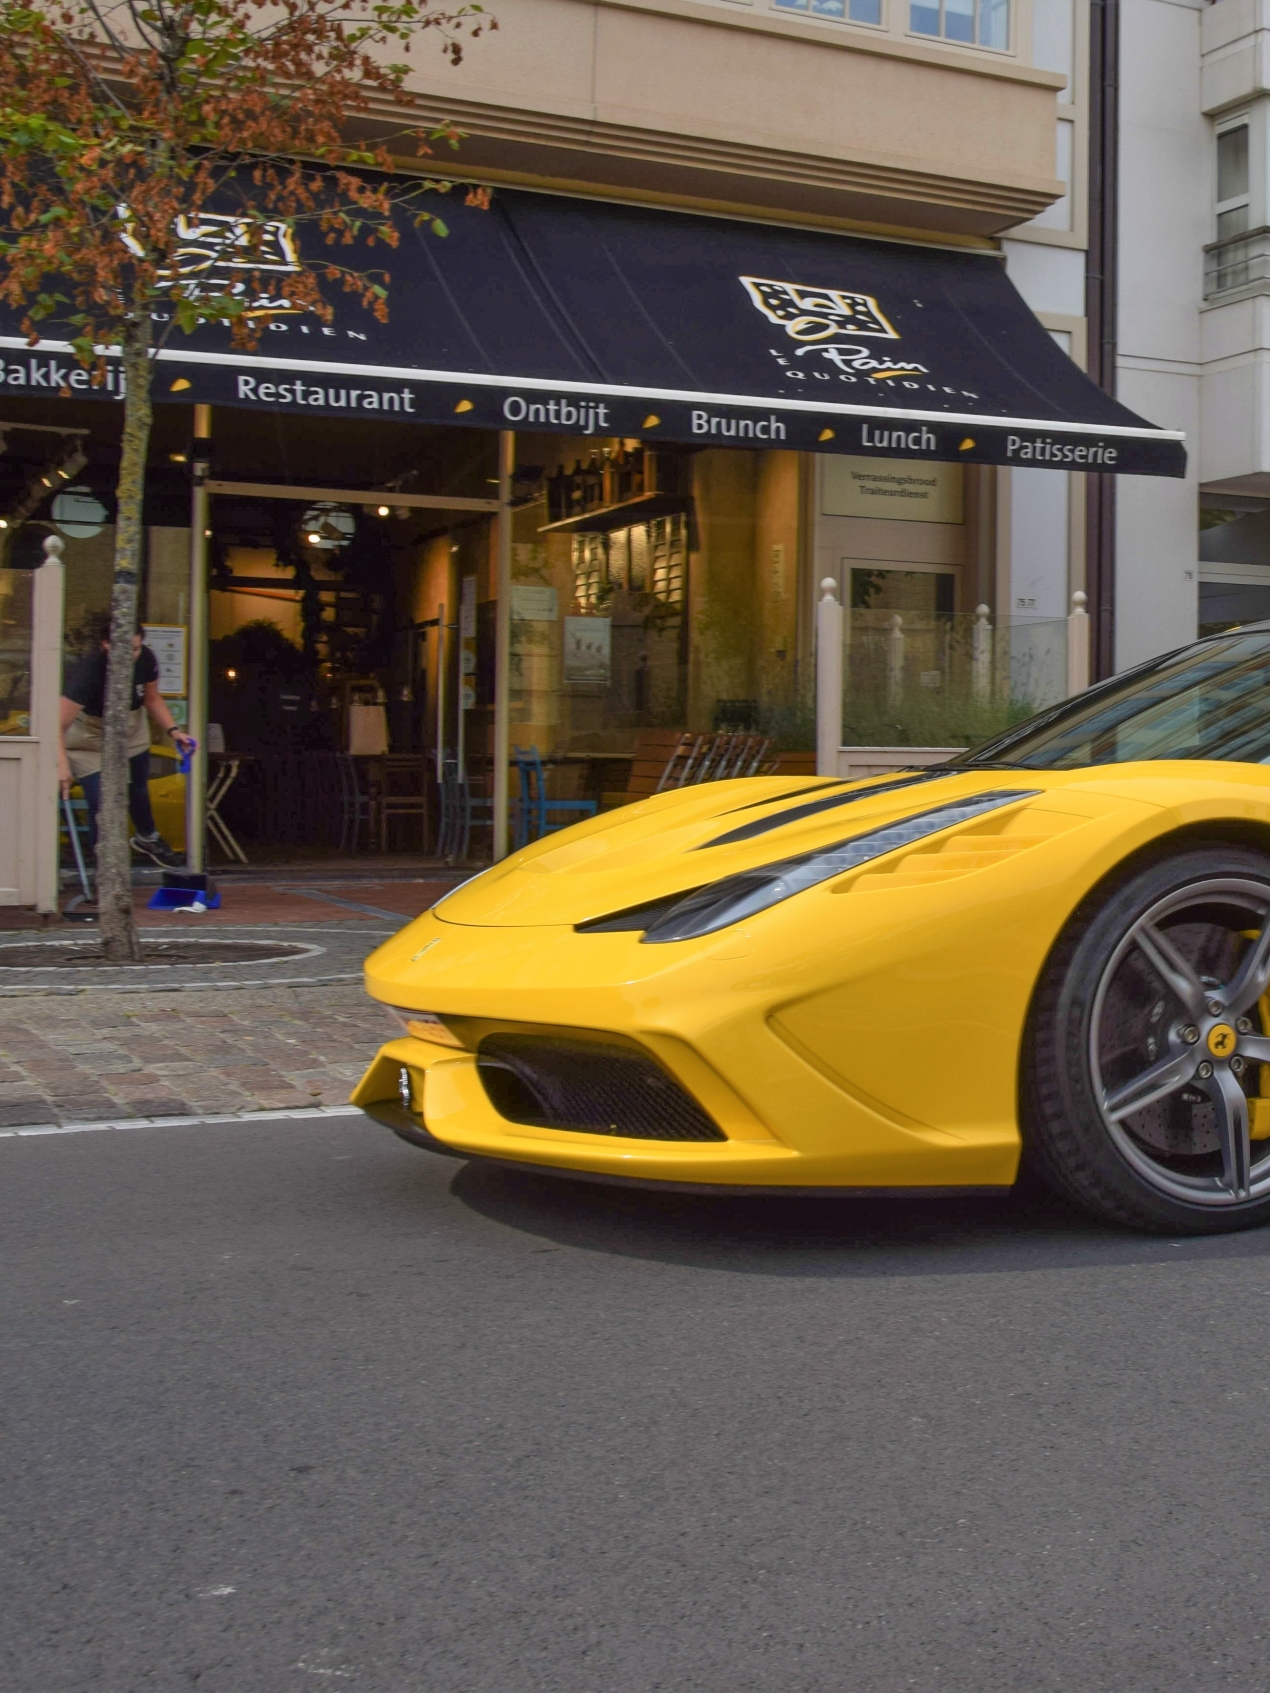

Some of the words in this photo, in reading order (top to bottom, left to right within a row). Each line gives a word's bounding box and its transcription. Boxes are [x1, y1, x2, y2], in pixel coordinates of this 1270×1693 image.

[795, 344, 930, 373] Pain
[785, 370, 980, 399] QUOTIDIEN
[237, 375, 416, 413] Restaurant
[503, 396, 610, 434] Ontbijt
[691, 410, 787, 440] Brunch
[861, 423, 937, 450] Lunch
[1006, 435, 1118, 465] Patisserie
[850, 470, 937, 487] Verrassingsbrood
[859, 485, 930, 499] Traiteurdienst
